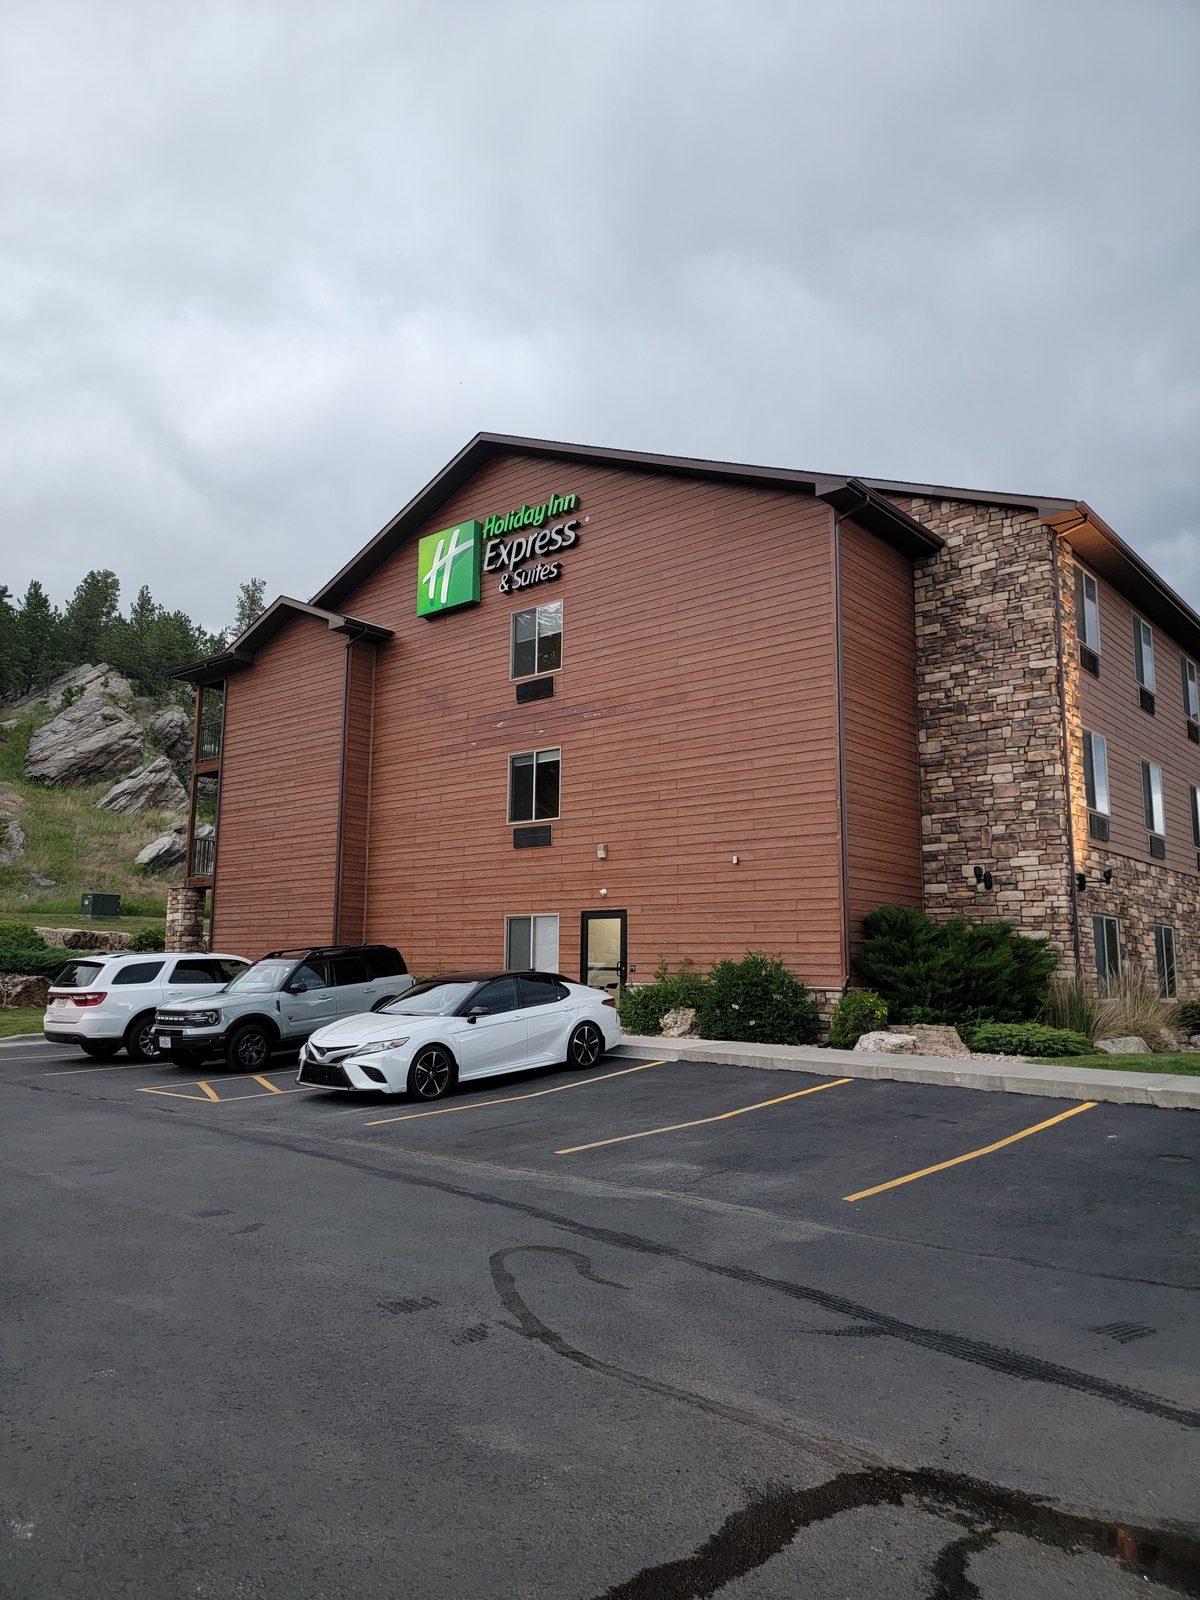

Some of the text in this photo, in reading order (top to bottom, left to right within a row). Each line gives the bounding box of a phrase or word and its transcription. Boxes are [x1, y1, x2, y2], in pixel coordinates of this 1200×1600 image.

[482, 493, 577, 539] Holiday Inn
[483, 520, 578, 571] Express
[498, 562, 559, 593] & Suites
